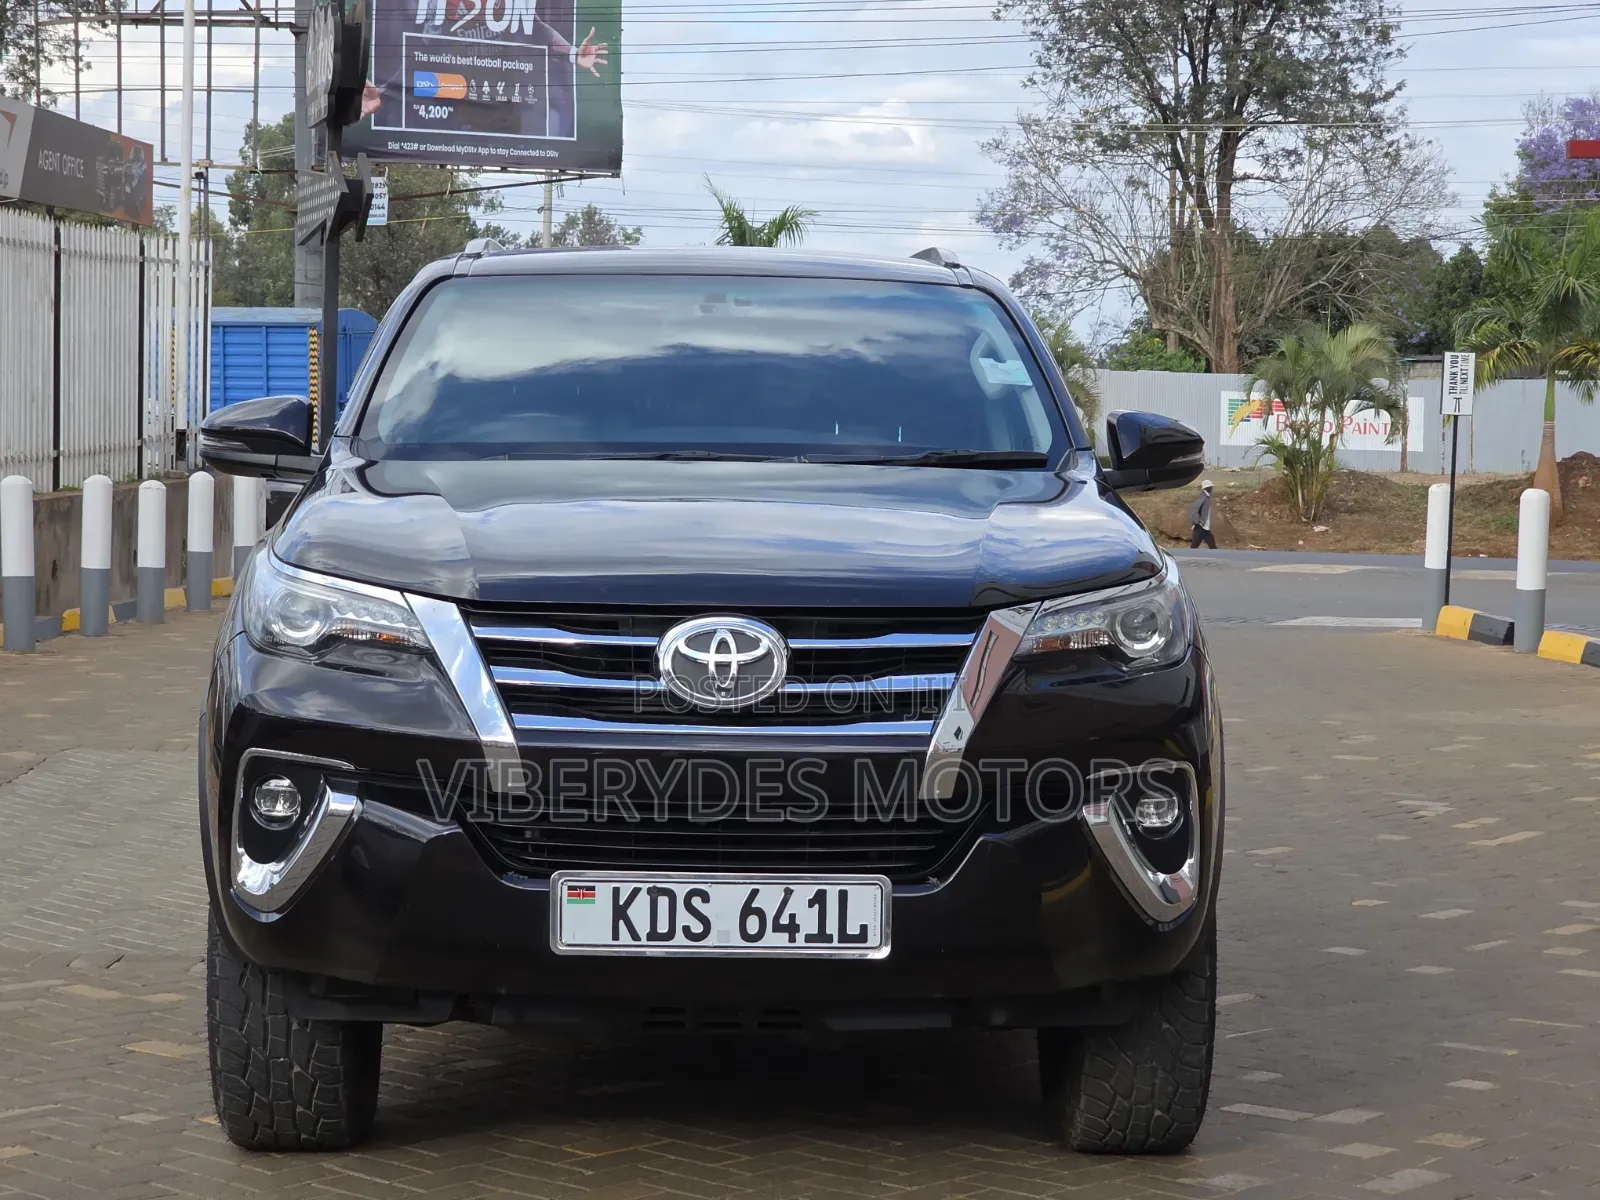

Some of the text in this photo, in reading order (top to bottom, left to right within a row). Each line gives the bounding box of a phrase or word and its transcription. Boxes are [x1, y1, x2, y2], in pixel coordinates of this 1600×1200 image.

[413, 51, 533, 74] The world's best football package
[418, 104, 449, 119] 4,200
[388, 141, 400, 150] Dial
[427, 143, 456, 152] Download
[456, 145, 477, 155] MyDStv
[478, 147, 490, 156] App
[490, 147, 497, 155] to
[497, 148, 509, 157] stay
[510, 148, 540, 157] Connected
[540, 149, 546, 157] to
[38, 149, 84, 178] AGENT OFFICE
[1449, 354, 1460, 395] THANK YOU
[1460, 368, 1469, 385] NEXT
[611, 886, 711, 942] KDS
[738, 888, 868, 944] 641L
